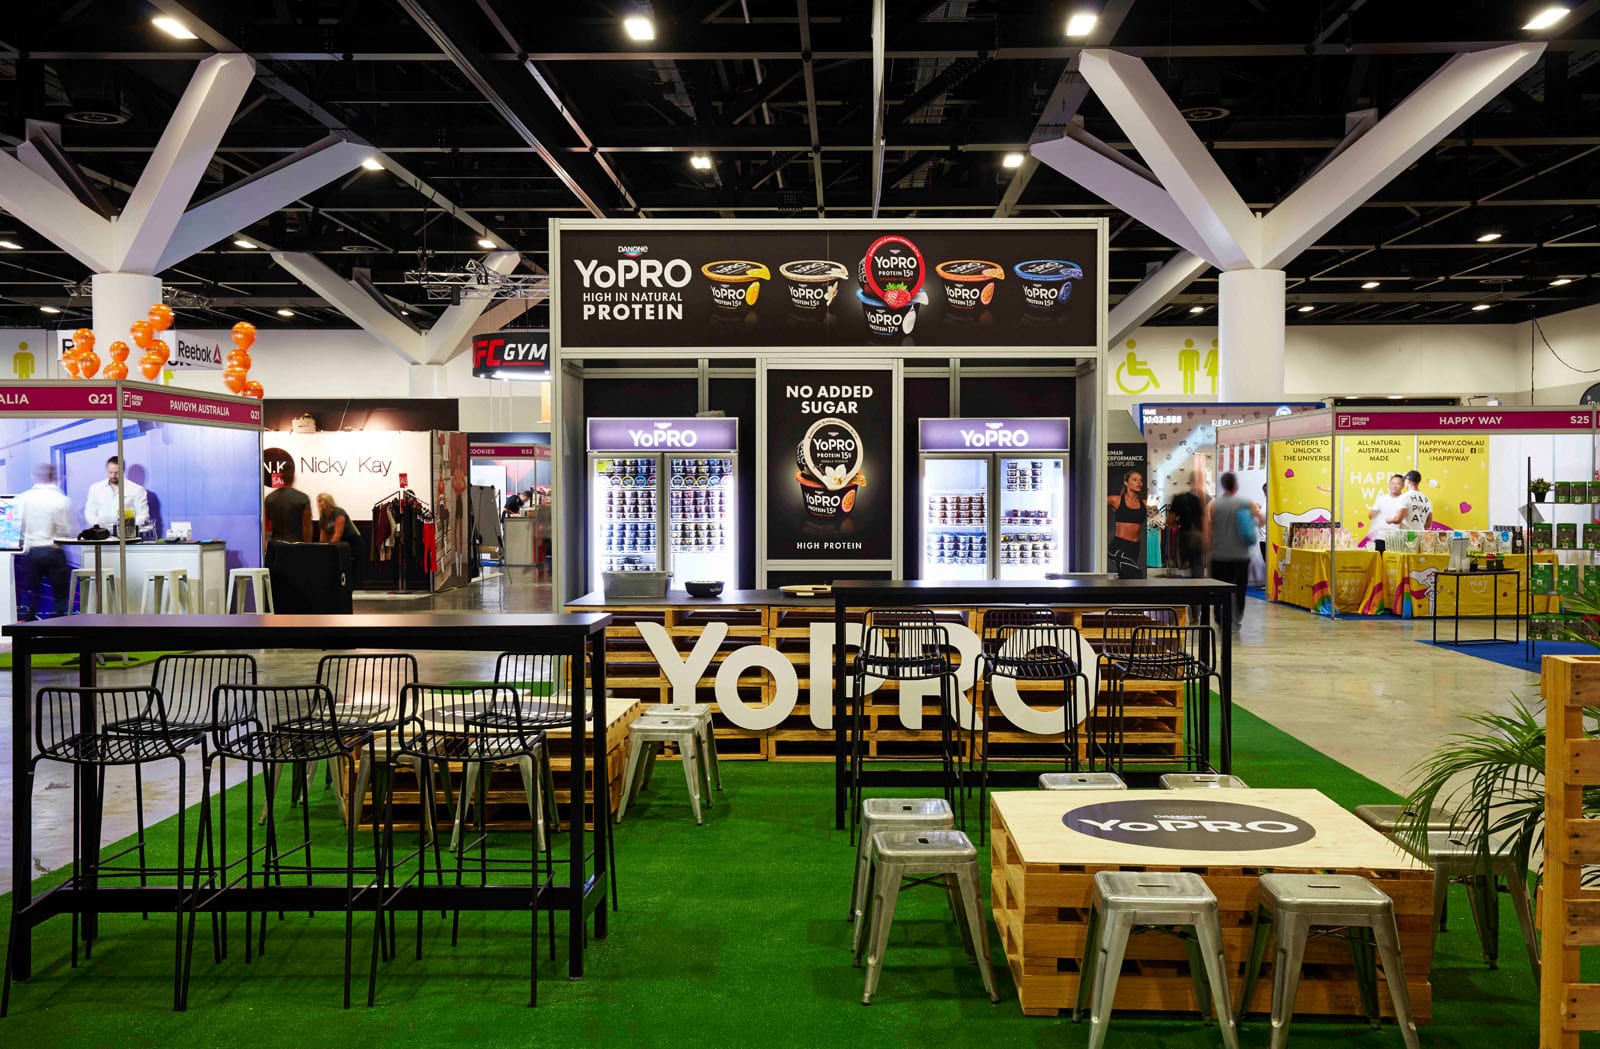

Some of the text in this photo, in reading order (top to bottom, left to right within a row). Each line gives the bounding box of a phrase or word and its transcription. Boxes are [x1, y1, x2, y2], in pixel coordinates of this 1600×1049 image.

[874, 256, 918, 269] YoPRO
[573, 258, 693, 289] YoPRO
[583, 292, 683, 302] HIGH IN NATURAL
[710, 285, 746, 300] YoPRO
[788, 284, 824, 300] YoPRO
[944, 285, 980, 300] YoPRO
[1022, 285, 1059, 300] YoPRO
[583, 303, 683, 320] PROTEIN
[865, 311, 903, 326] YoPRO
[178, 340, 212, 364] Reebok
[503, 343, 548, 361] GYM
[88, 393, 114, 405] Q21
[786, 385, 874, 398] NO ADDED
[169, 400, 261, 419] PAVIGYM AUSTRALIA Q21
[801, 401, 859, 414] SUGAR
[1439, 415, 1590, 425] HAPPY WAY S25
[628, 430, 697, 447] YoPRO
[813, 439, 855, 451] YoPRO
[960, 430, 1030, 447] YoPRO
[301, 457, 392, 476] Nicky Kay
[1350, 471, 1406, 485] HAPP
[804, 492, 841, 507] YoPRO
[796, 542, 862, 550] HIGH PROTEIN
[634, 622, 1101, 735] YoPRO
[1077, 818, 1299, 833] YoPRO
